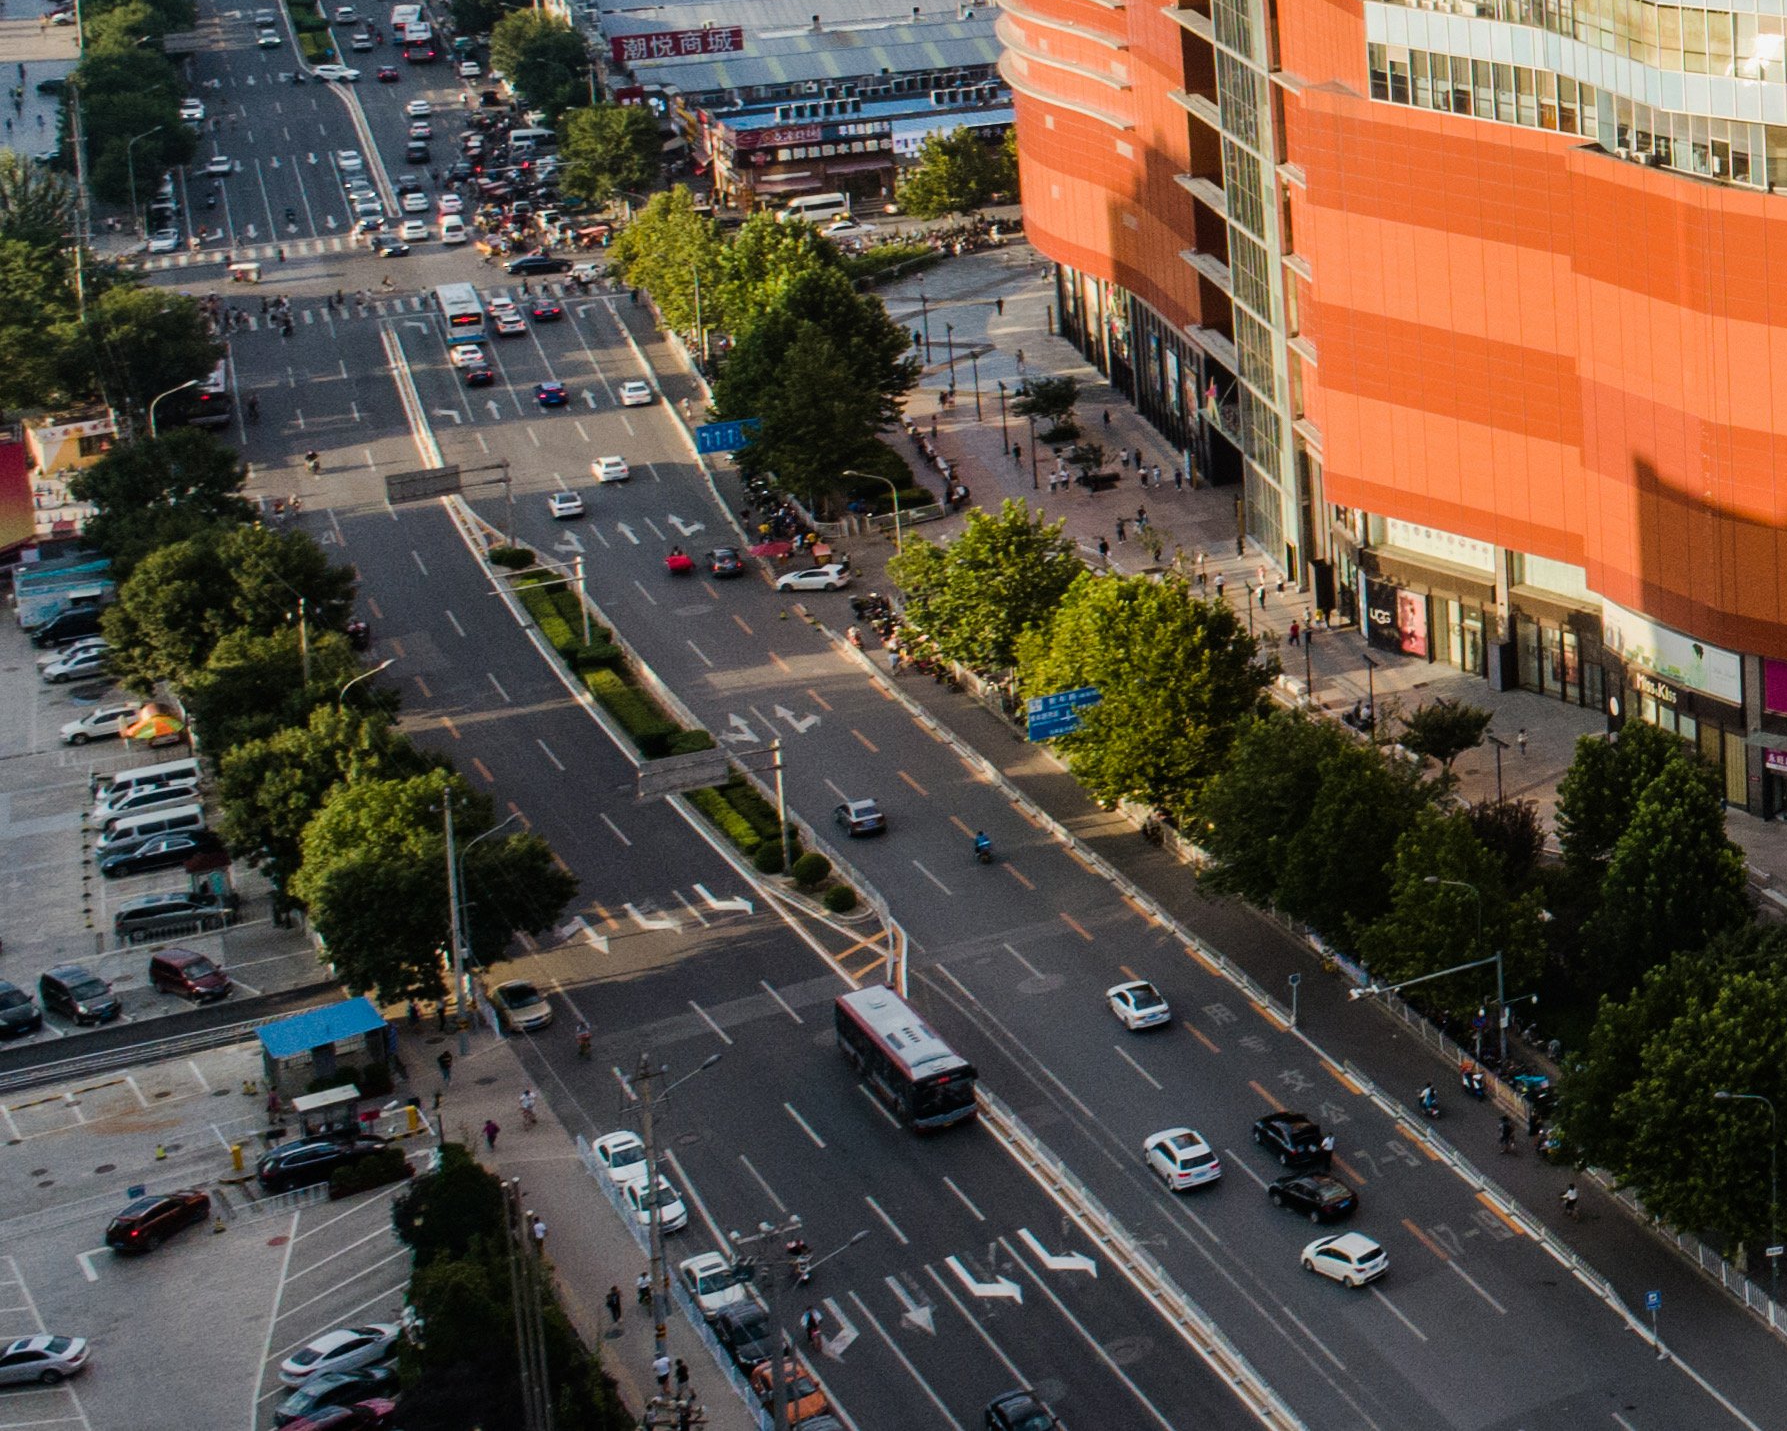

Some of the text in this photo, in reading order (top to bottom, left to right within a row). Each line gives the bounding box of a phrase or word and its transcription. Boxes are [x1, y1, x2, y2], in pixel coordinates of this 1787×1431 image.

[623, 30, 734, 59] 潮悦商城
[1370, 608, 1391, 625] UGG
